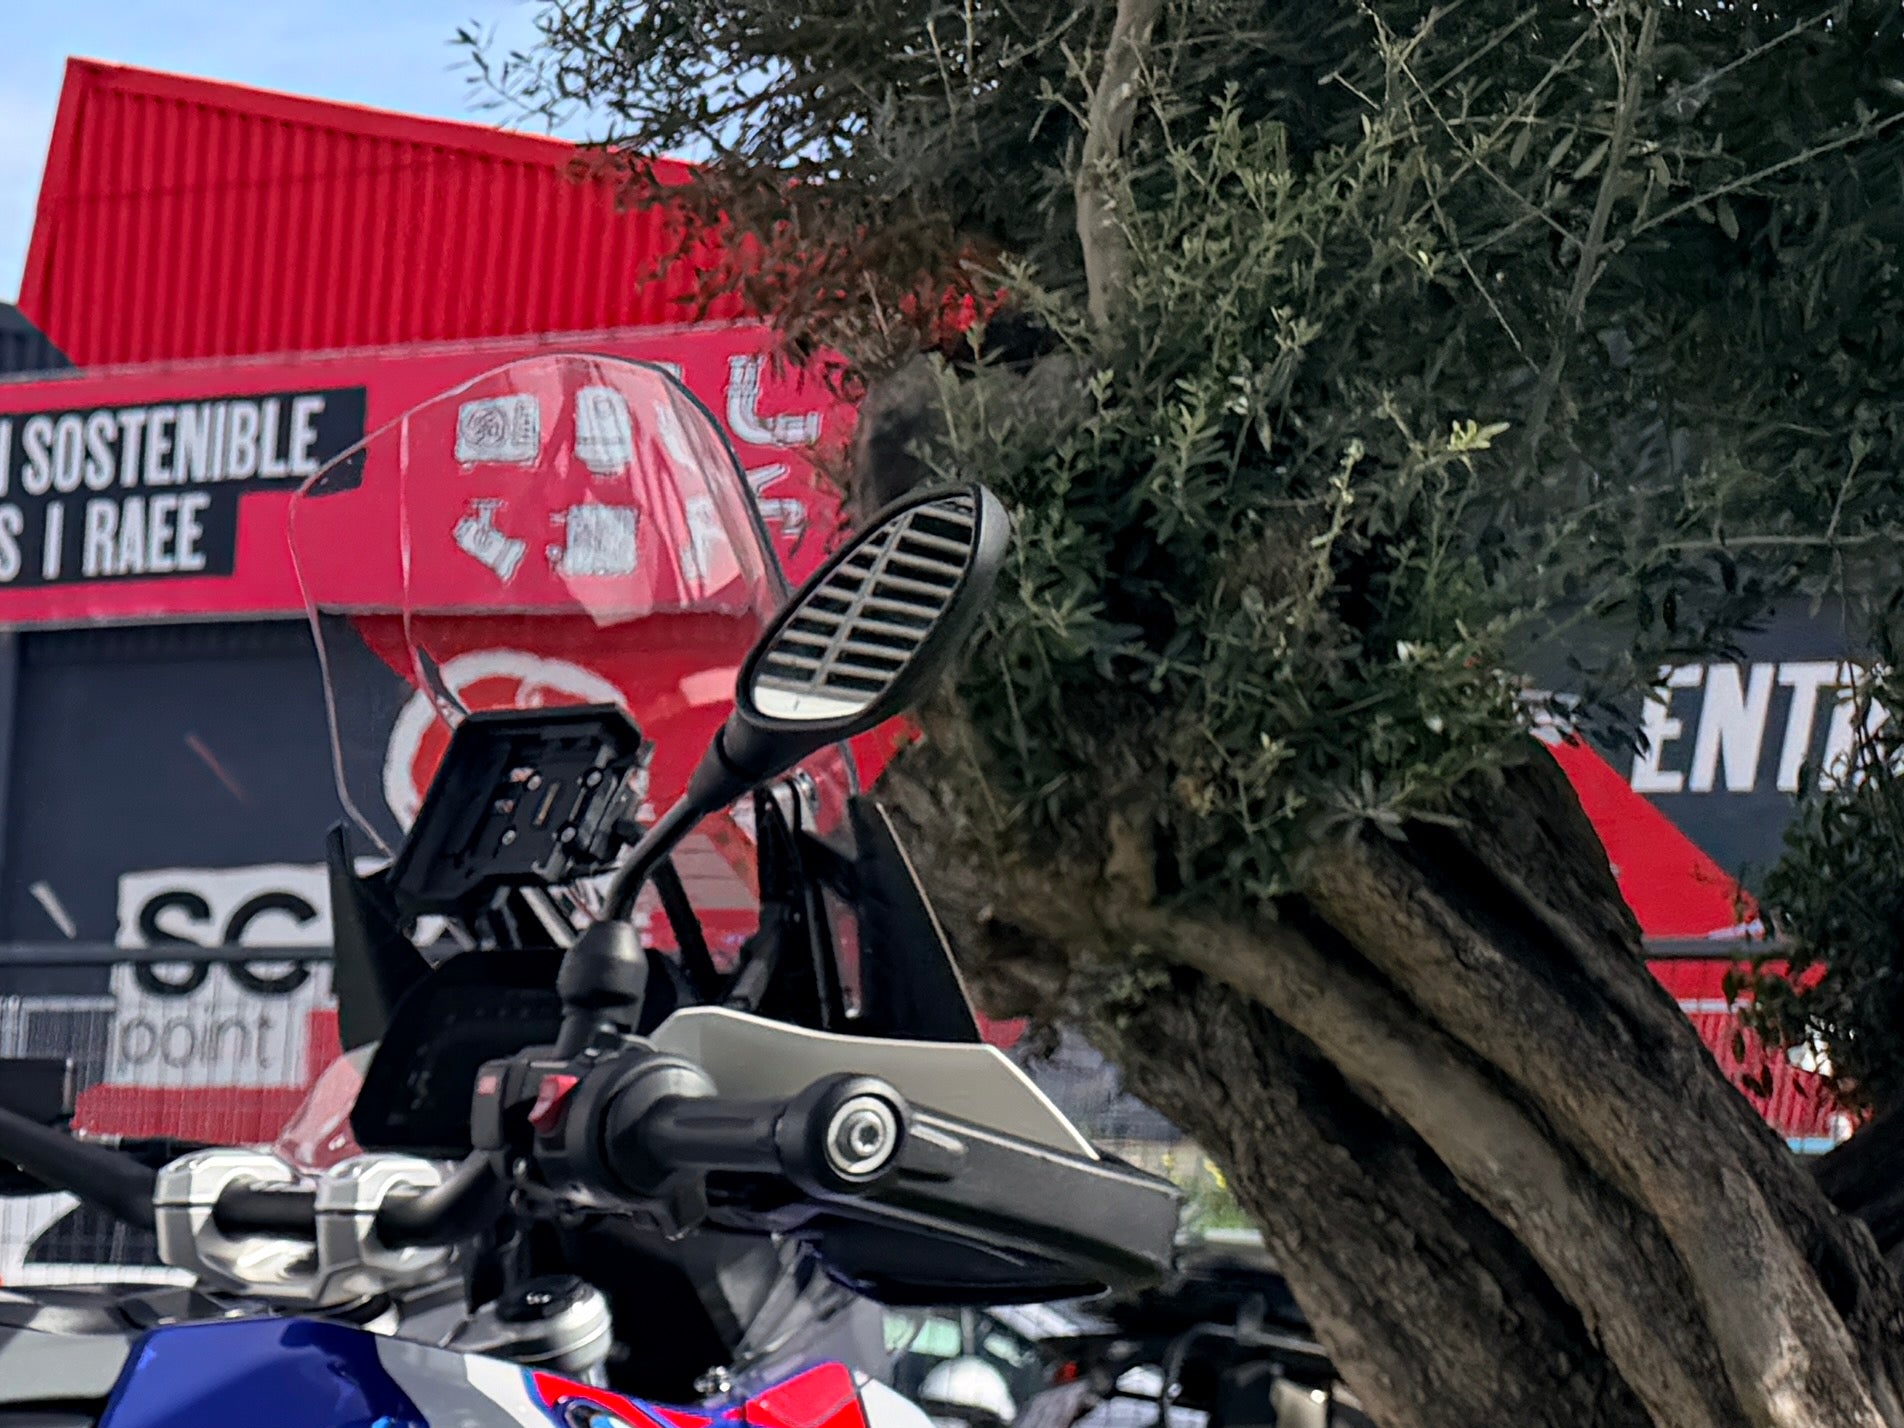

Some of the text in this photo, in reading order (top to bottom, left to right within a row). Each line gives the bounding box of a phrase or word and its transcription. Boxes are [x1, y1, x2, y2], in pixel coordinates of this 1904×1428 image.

[21, 395, 326, 492] SOSTENIBLE
[42, 502, 64, 579] I
[81, 493, 211, 577] RAEE
[118, 1008, 278, 1072] point
